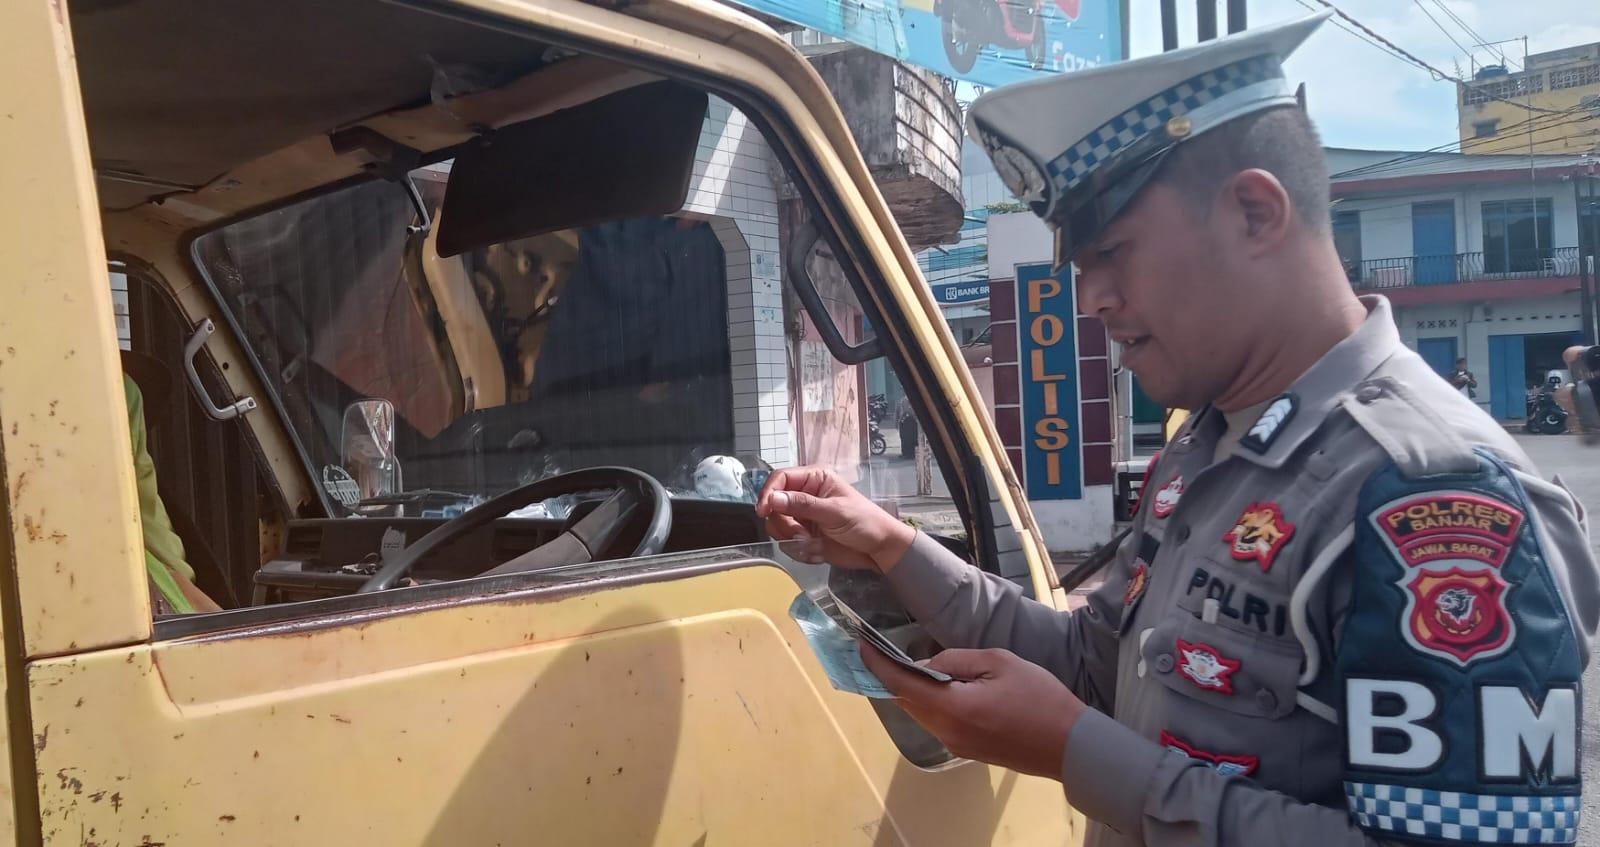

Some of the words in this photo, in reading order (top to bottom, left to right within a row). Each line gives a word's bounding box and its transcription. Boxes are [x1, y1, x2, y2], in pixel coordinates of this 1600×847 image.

[957, 287, 979, 296] BANK
[980, 286, 990, 294] BR
[1028, 279, 1069, 485] POLISI
[1387, 502, 1511, 528] POLRES
[1410, 515, 1493, 531] BANJAR
[1411, 543, 1446, 559] JAWA
[1450, 543, 1496, 559] BARAT
[1186, 567, 1287, 637] POLRI
